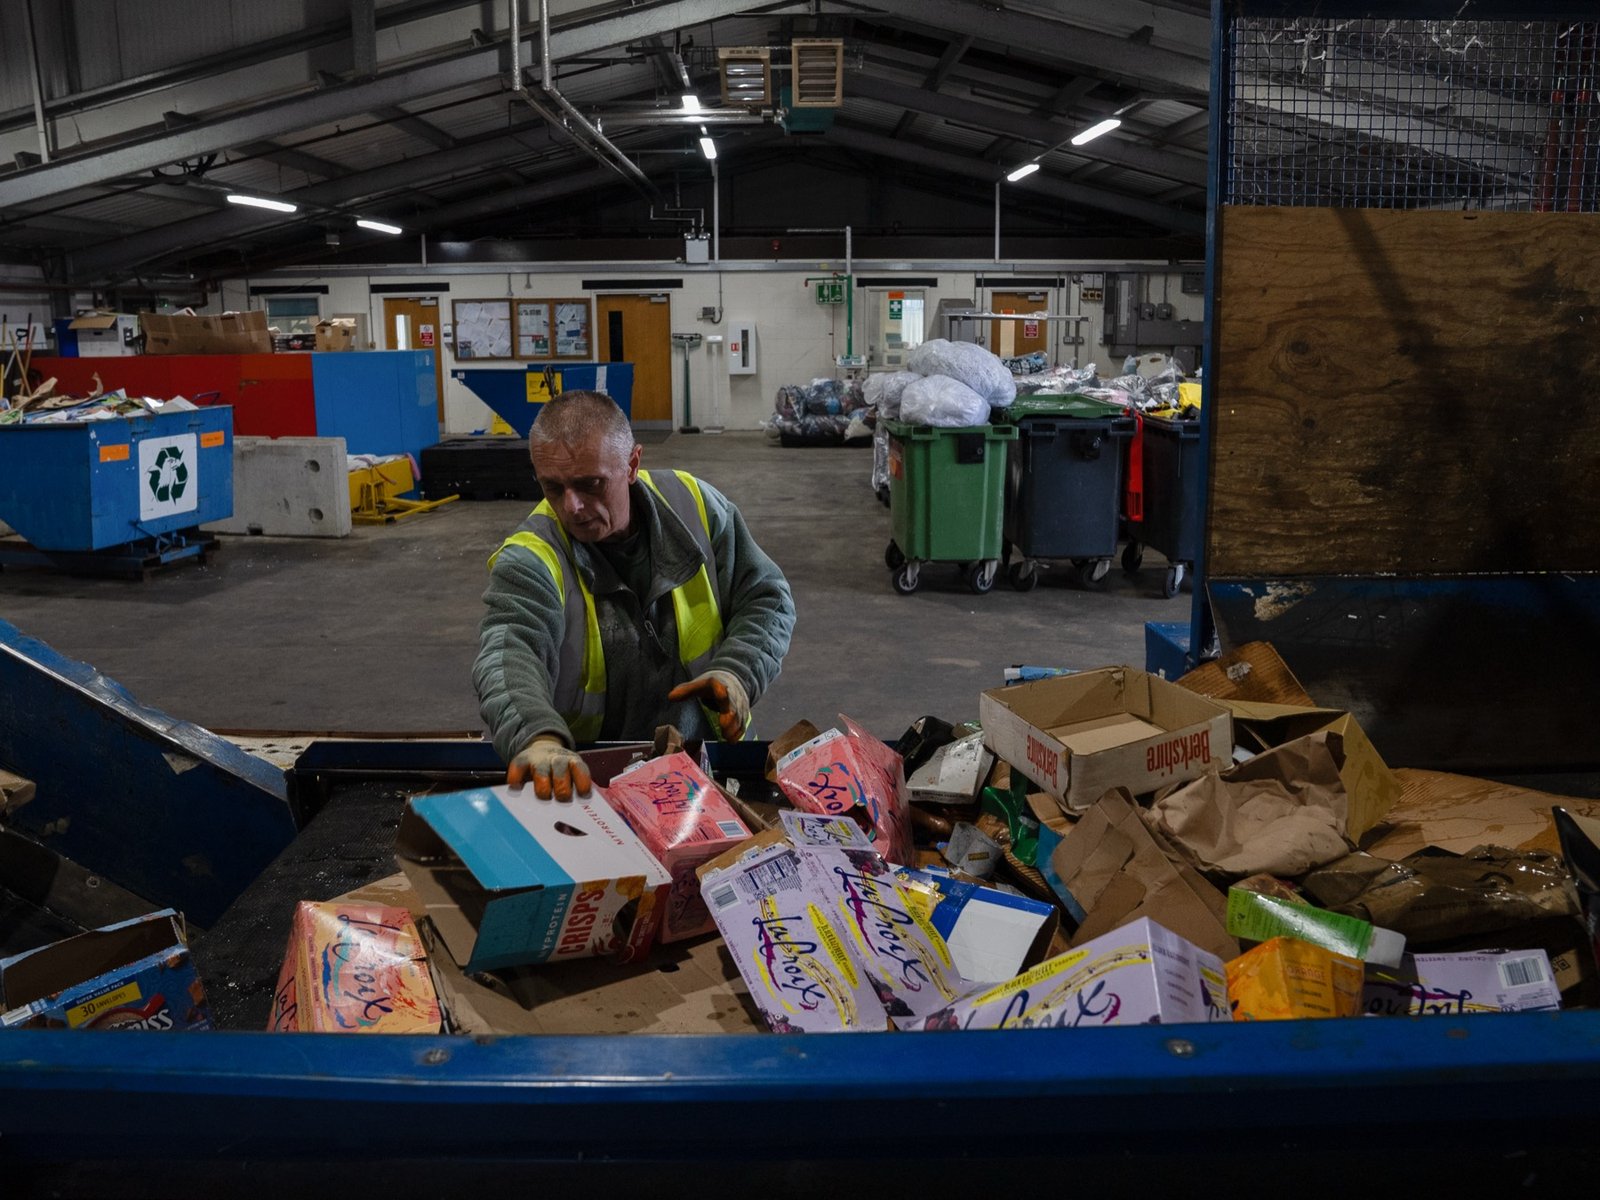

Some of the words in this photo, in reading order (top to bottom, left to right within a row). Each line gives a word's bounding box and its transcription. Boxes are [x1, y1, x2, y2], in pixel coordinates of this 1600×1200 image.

[1026, 733, 1059, 790] Berkshire
[1147, 729, 1211, 777] Berkshire
[581, 803, 625, 846] MYPROTEIN
[537, 892, 568, 959] MYPROTEIN
[556, 888, 605, 956] CRISPS
[752, 914, 826, 1009] LaCroix
[75, 993, 94, 1005] SUPER
[94, 986, 111, 998] VALUE
[110, 980, 125, 990] PACK
[80, 1002, 97, 1017] 30
[95, 991, 127, 1009] ENVELOPES
